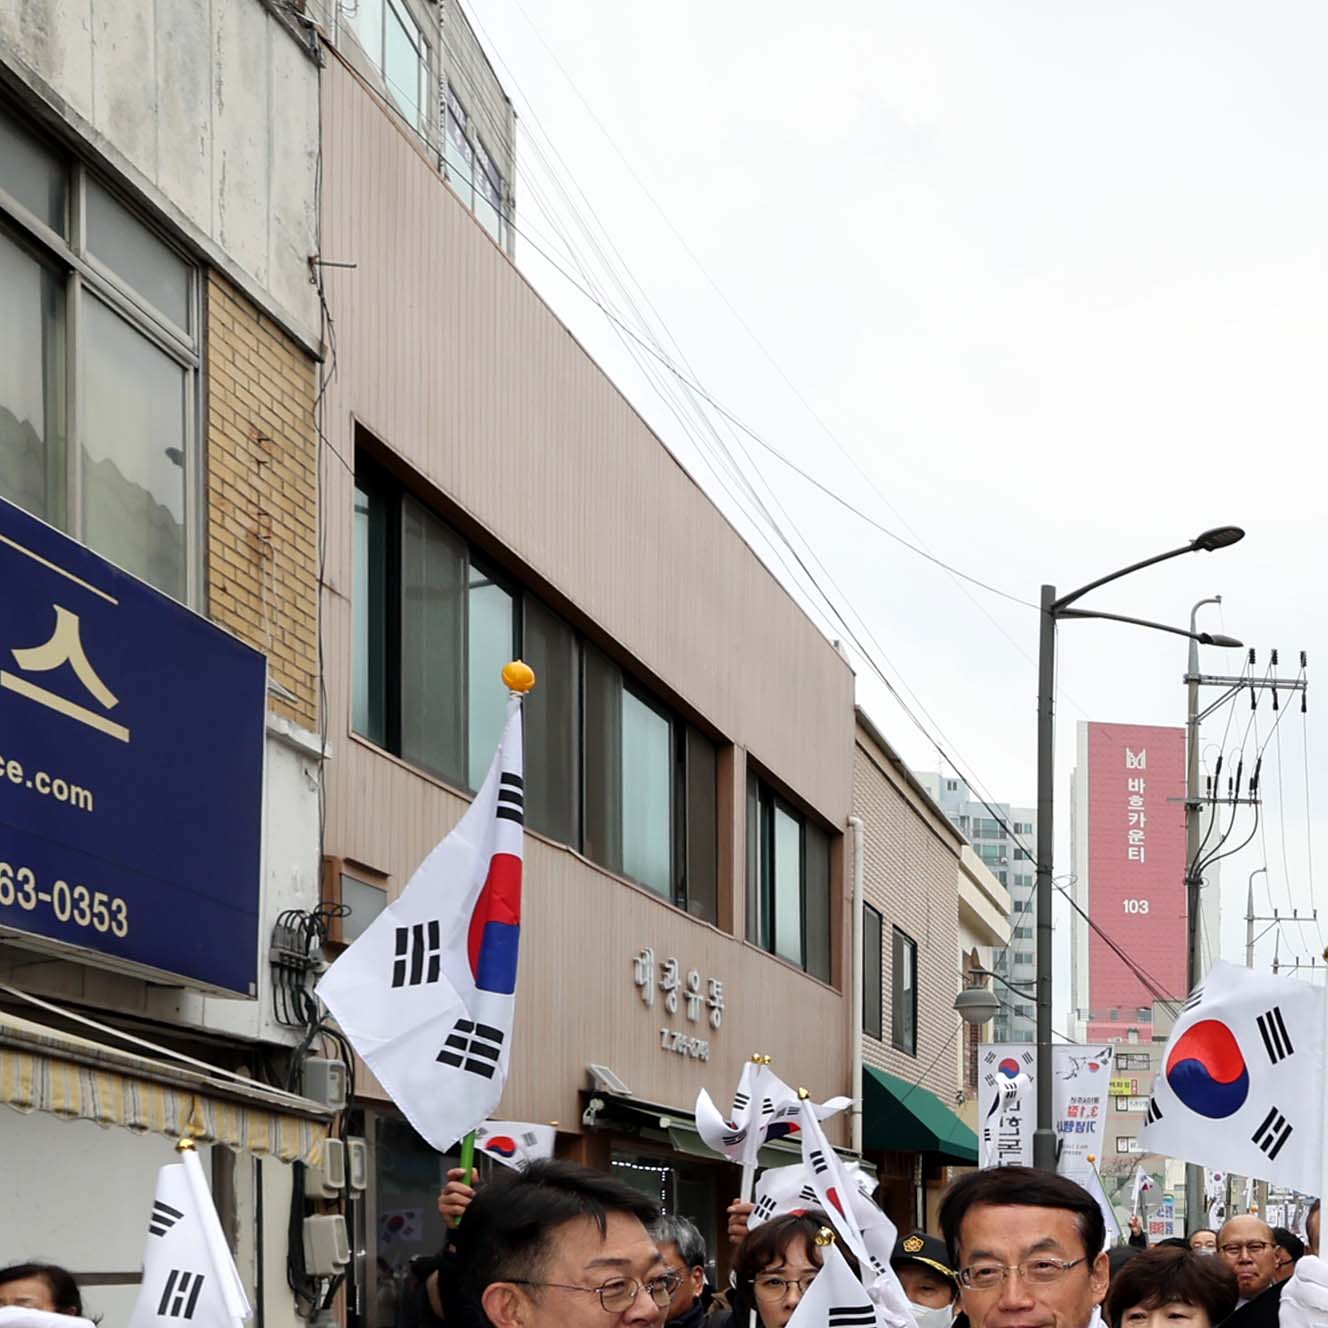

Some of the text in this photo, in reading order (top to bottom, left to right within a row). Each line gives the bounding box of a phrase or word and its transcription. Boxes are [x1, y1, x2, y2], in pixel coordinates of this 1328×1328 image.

[1127, 777, 1147, 863] 바흐카운티
[0, 862, 129, 938] 63-0353
[1123, 898, 1150, 914] 103
